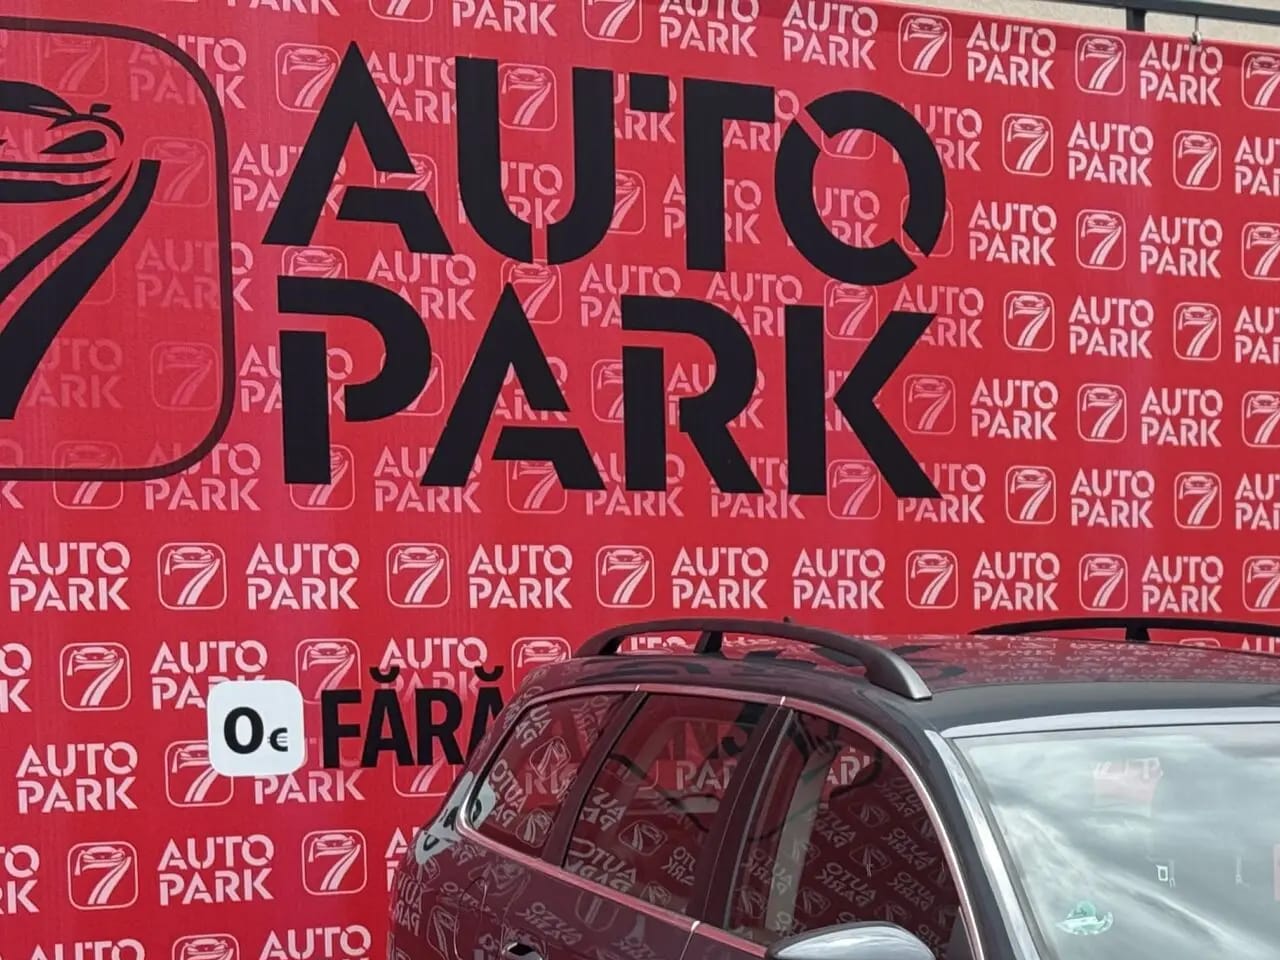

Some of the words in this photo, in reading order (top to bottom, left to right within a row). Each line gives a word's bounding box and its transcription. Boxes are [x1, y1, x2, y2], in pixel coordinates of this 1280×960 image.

[452, 0, 557, 37] PARK
[783, 1, 879, 37] AUTO
[661, 23, 757, 57] PARK
[784, 30, 875, 70] PARK
[967, 21, 1056, 57] AUTO
[968, 51, 1054, 89] PARK
[1139, 40, 1223, 75] AUTO
[1140, 70, 1220, 106] PARK
[915, 103, 983, 138] UTO
[1068, 120, 1153, 155] AUTO
[262, 40, 945, 286] AUTO
[1069, 150, 1152, 186] PARK
[969, 200, 1056, 235] AUTO
[1140, 215, 1222, 247] AUTO
[970, 231, 1055, 266] PARK
[1141, 245, 1220, 278] PARK
[367, 250, 477, 286] AUTO
[579, 263, 681, 297] AUTO
[705, 272, 803, 305] AUTO
[893, 283, 984, 317] AUTO
[1069, 296, 1153, 328] AUTO
[42, 339, 123, 371] UTO
[1070, 325, 1152, 358] PARK
[27, 374, 122, 408] ARK
[277, 275, 943, 499] PARK
[971, 378, 1058, 409] AUTO
[1141, 387, 1223, 417] AUTO
[972, 408, 1056, 440] PARK
[1142, 416, 1221, 447] PARK
[923, 463, 986, 493] UTO
[1071, 468, 1154, 498] AUTO
[145, 480, 261, 511] PARK
[374, 480, 481, 513] PARK
[585, 487, 684, 517] PARK
[711, 487, 805, 519] PARK
[897, 497, 985, 524] PARK
[1072, 498, 1153, 528] PARK
[8, 542, 130, 575] AUTO
[246, 543, 359, 575] AUTO
[468, 544, 572, 575] AUTO
[671, 547, 768, 577] AUTO
[792, 549, 885, 578] AUTO
[973, 552, 1060, 581] AUTO
[1142, 556, 1223, 583] AUTO
[10, 577, 129, 611] PARK
[248, 577, 358, 609] PARK
[470, 577, 571, 608] PARK
[673, 579, 767, 608] PARK
[794, 579, 883, 609] PARK
[974, 581, 1058, 610] PARK
[1143, 585, 1221, 612] PARK
[150, 640, 268, 674] AUTO
[379, 637, 487, 670] AUTO
[16, 742, 137, 777] AUTO
[18, 777, 136, 813] PARK
[255, 771, 365, 804] PARK
[158, 834, 274, 871] AUTO
[160, 868, 273, 905] PARK
